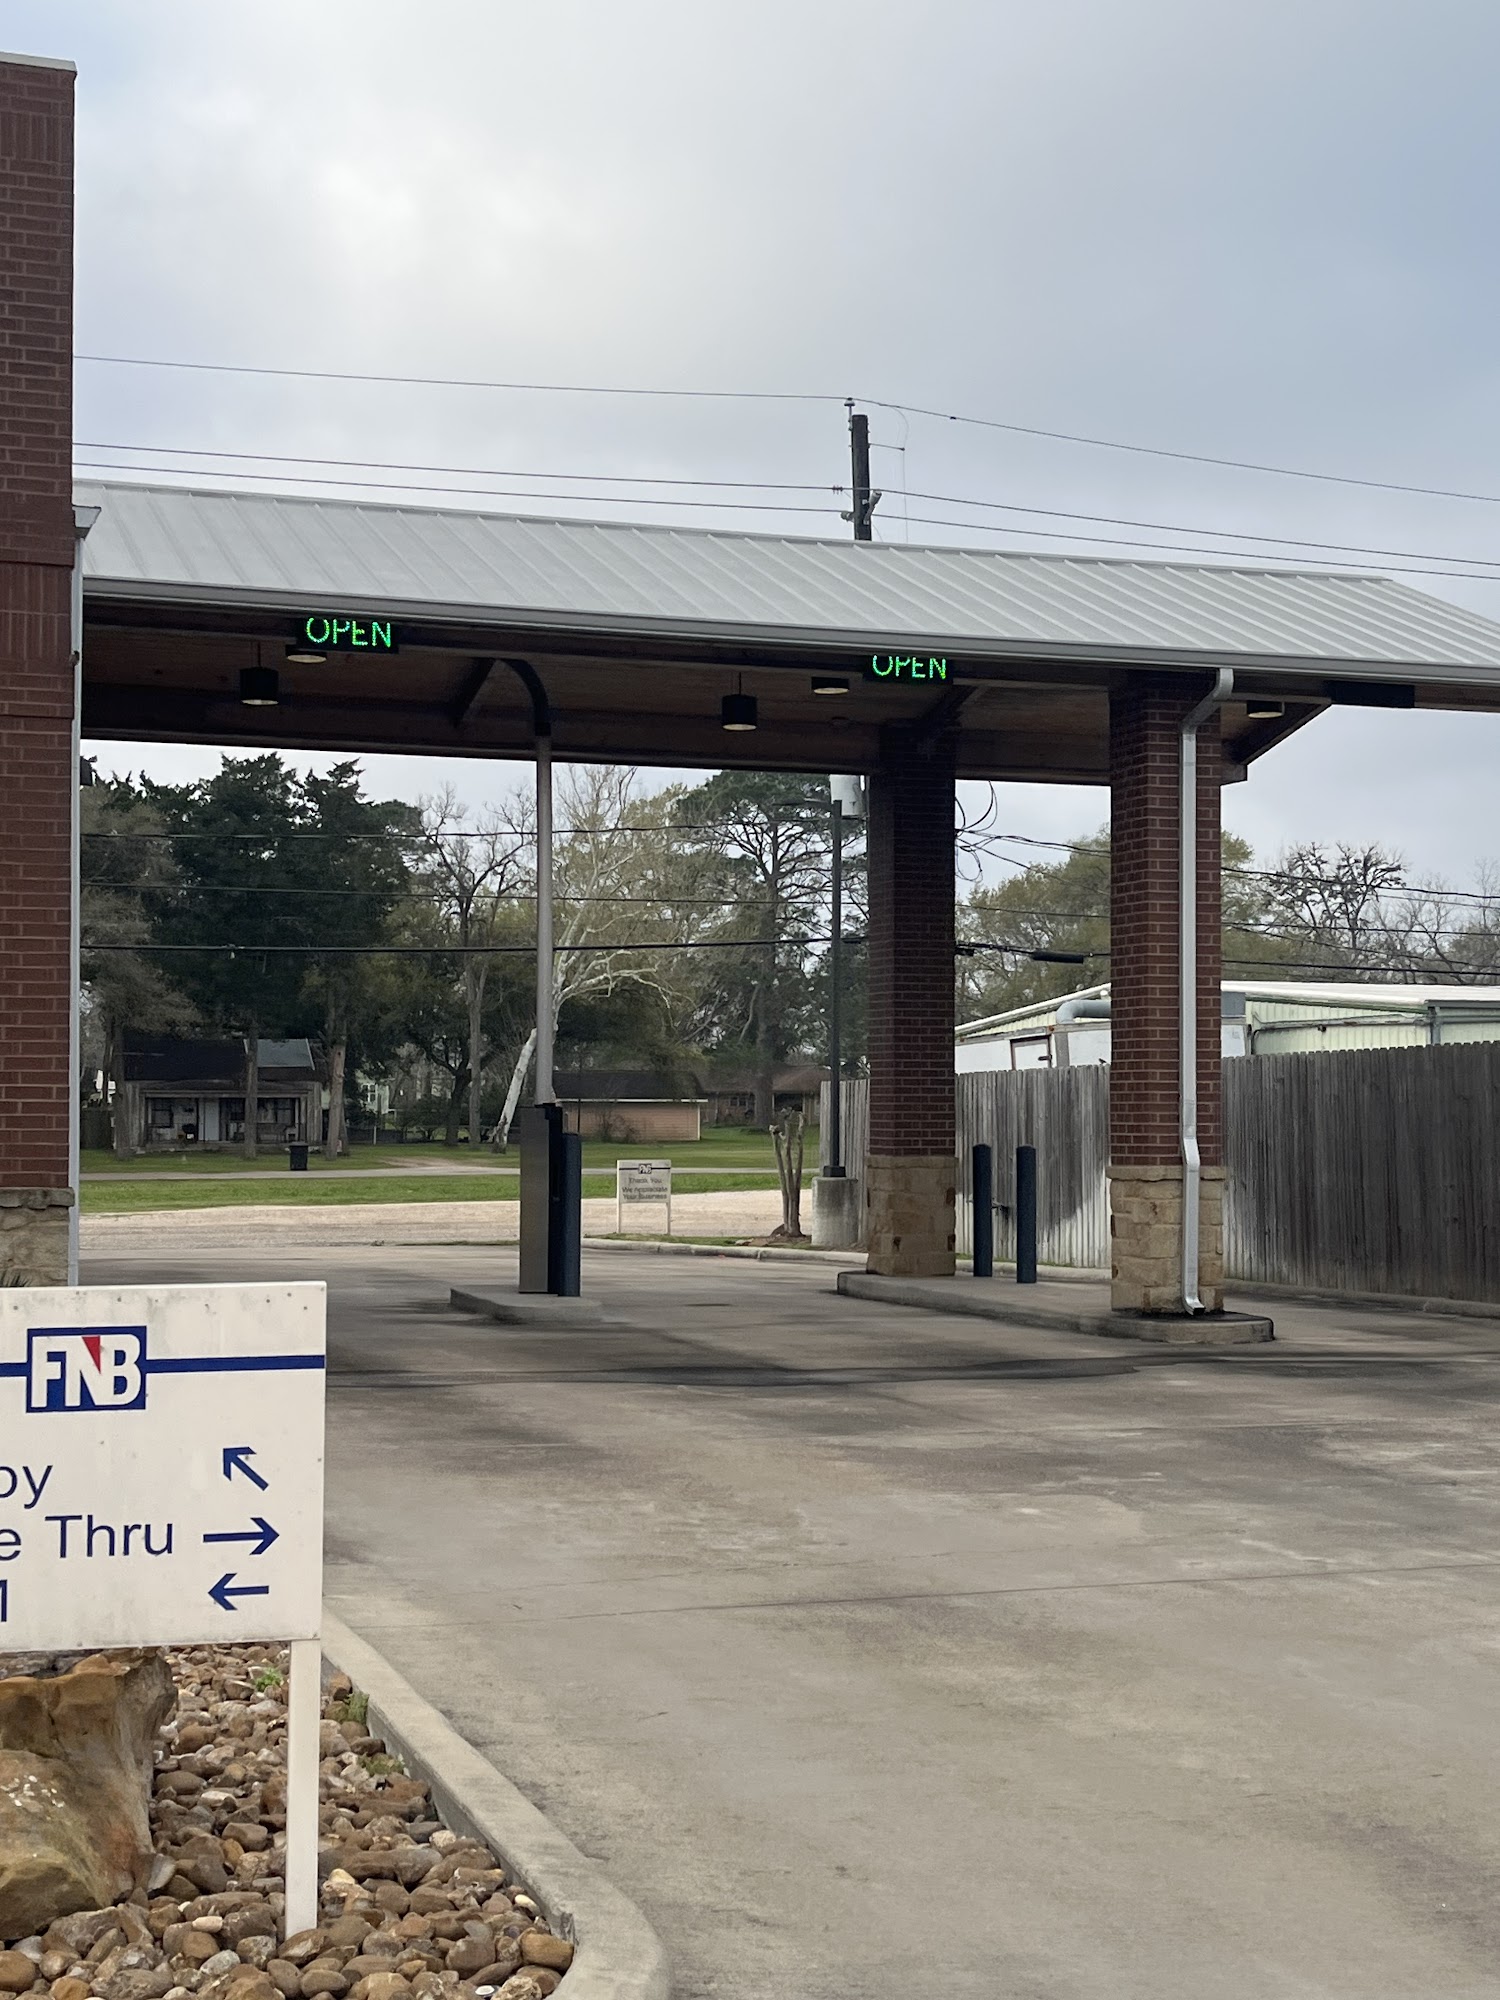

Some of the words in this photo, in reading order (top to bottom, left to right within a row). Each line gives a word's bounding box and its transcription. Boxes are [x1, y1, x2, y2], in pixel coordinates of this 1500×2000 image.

[306, 617, 391, 648] OPEN
[872, 654, 947, 679] OPEN
[30, 1332, 142, 1409] FNB
[45, 1514, 173, 1559] Thru
